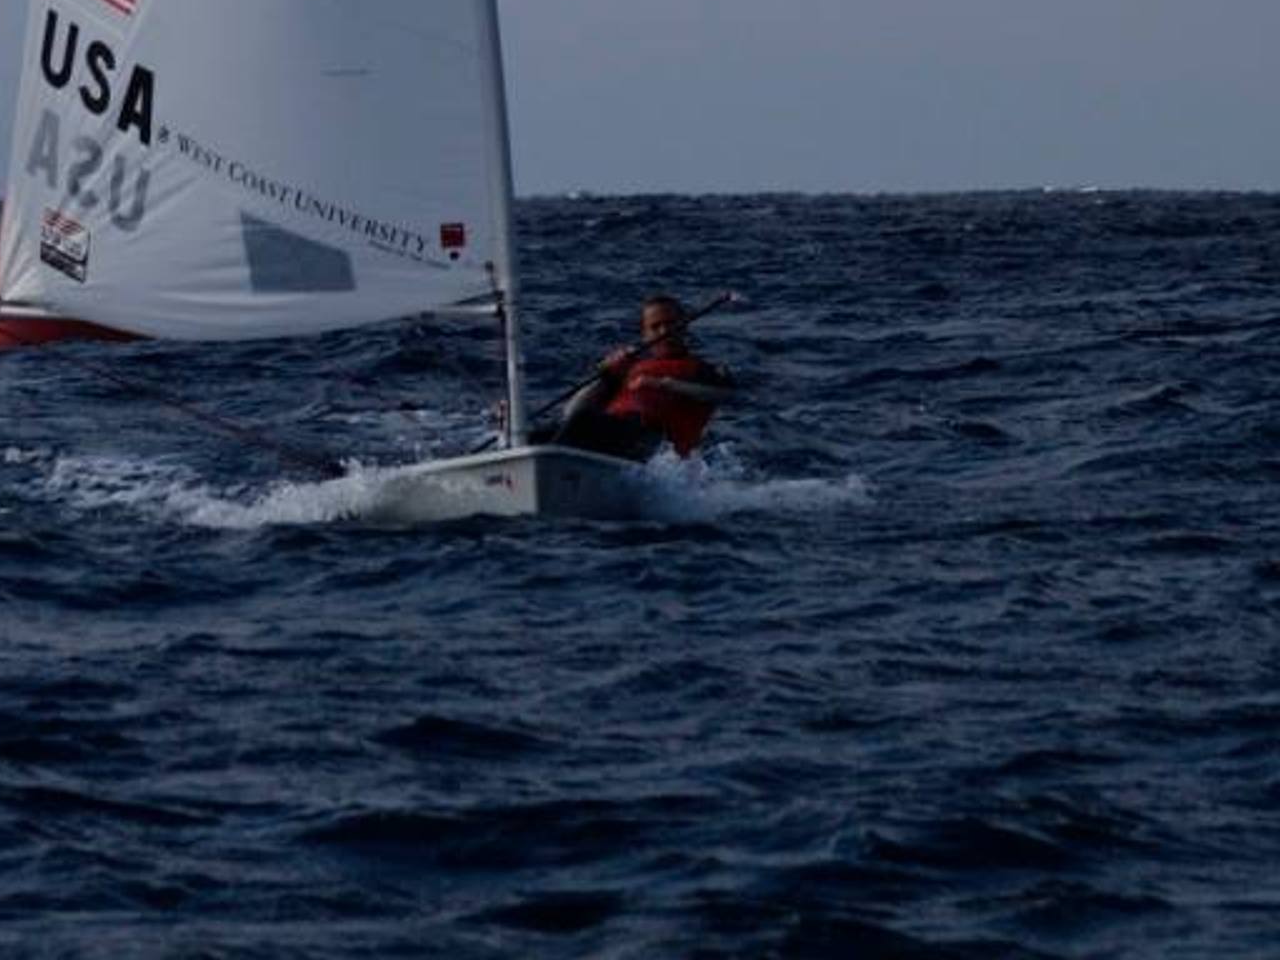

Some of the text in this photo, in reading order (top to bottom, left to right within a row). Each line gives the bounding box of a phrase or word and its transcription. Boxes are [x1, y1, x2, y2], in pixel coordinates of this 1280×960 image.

[41, 9, 154, 146] USA
[176, 131, 428, 254] WEST COAST UNIVERSITY
